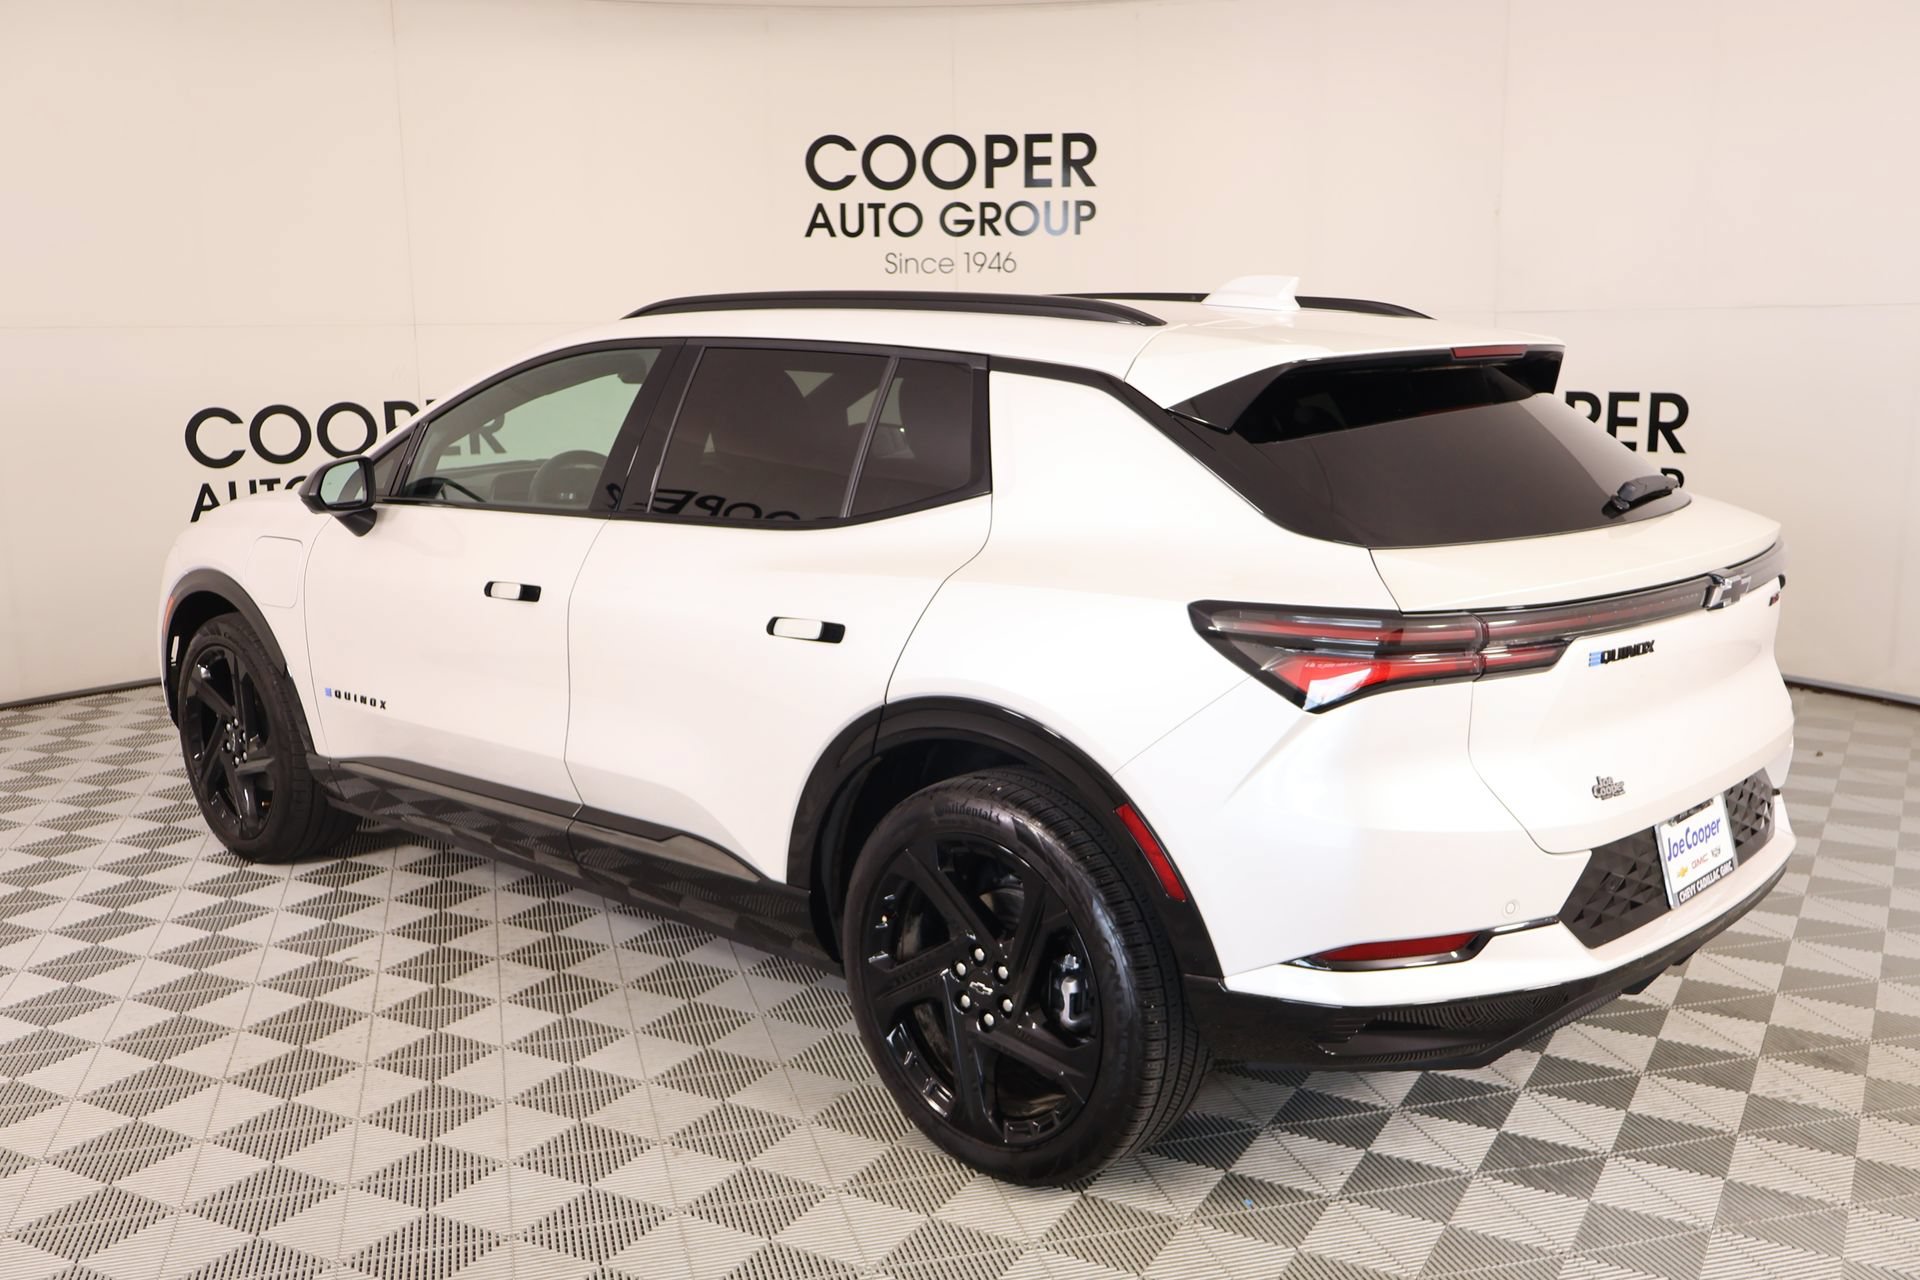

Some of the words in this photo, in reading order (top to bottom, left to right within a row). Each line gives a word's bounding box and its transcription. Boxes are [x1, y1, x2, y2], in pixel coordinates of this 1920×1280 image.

[805, 133, 1098, 191] COOPER
[804, 202, 923, 238] AUTO
[939, 200, 1097, 237] GROUP
[884, 252, 955, 275] Since
[964, 251, 1017, 274] 1946
[1679, 881, 1697, 903] CHEVY
[1696, 868, 1720, 892] CADILLAC
